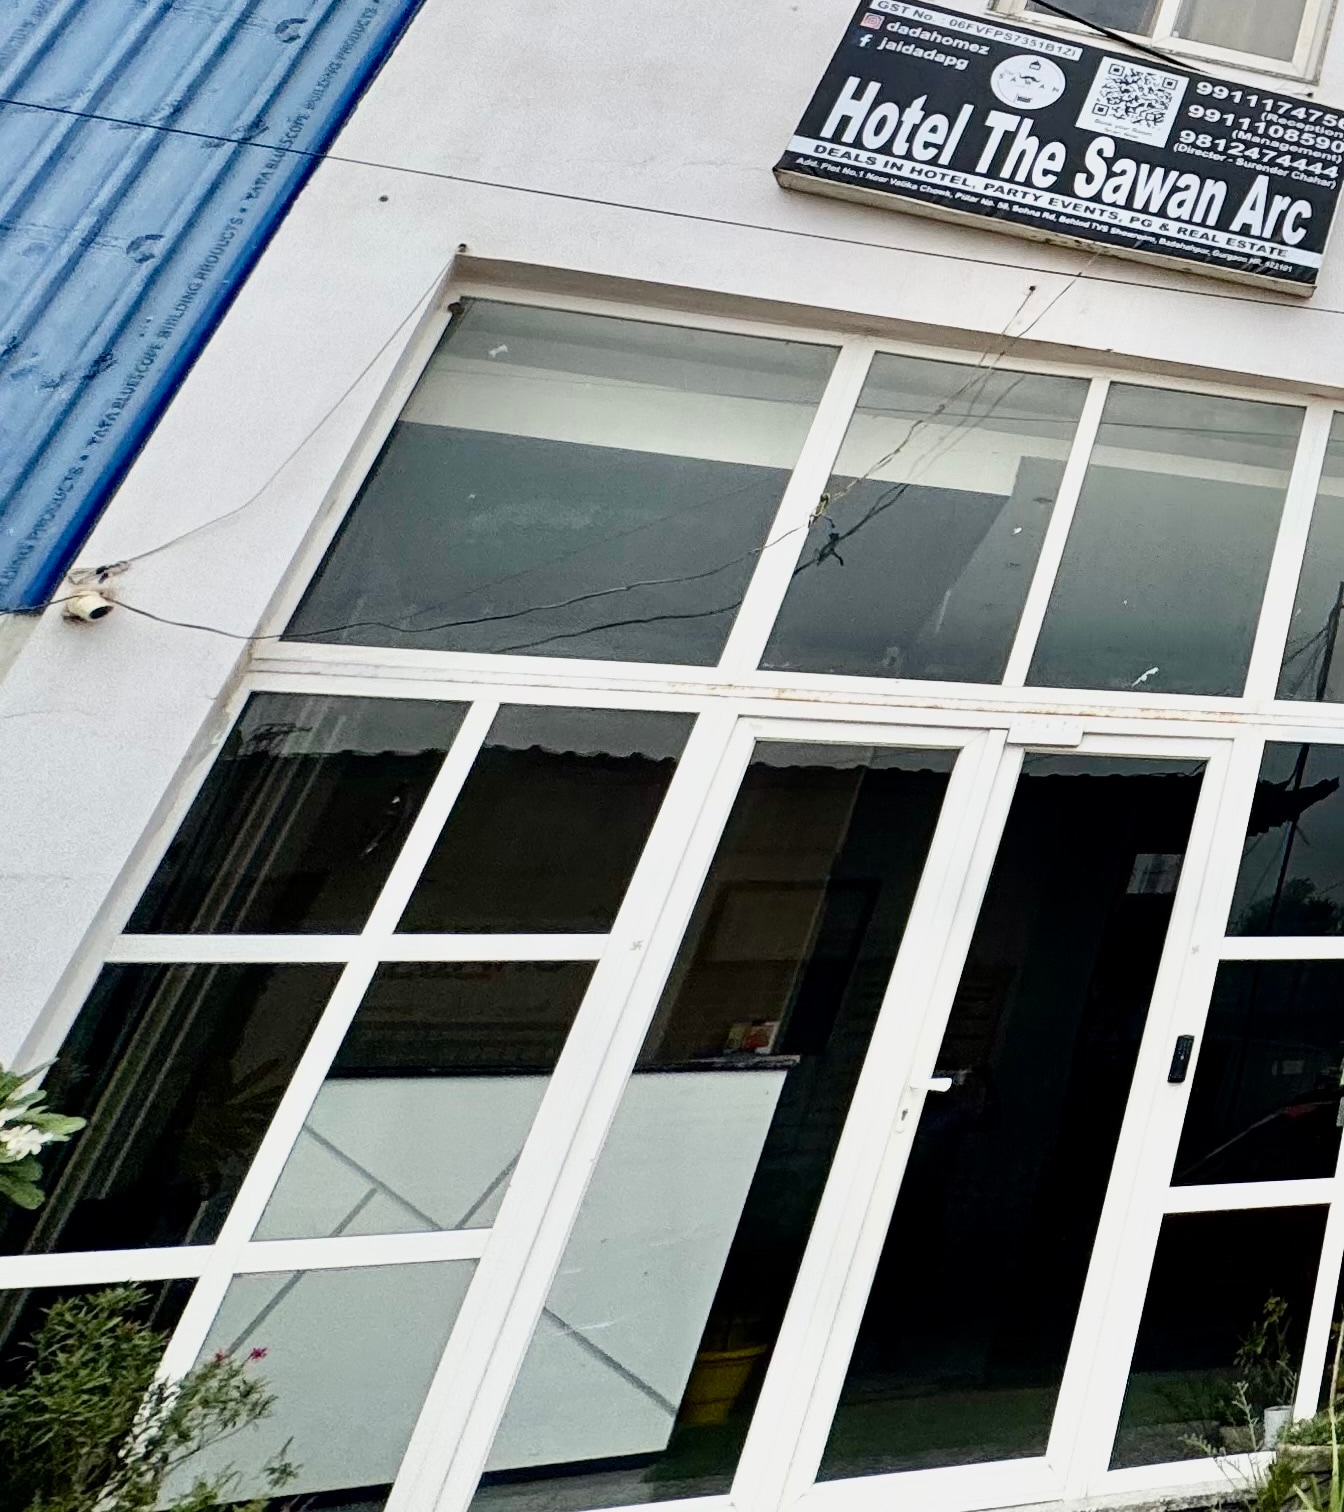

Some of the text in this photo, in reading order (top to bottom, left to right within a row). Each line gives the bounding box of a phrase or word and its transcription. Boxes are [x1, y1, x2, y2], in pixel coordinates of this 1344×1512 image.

[877, 0, 910, 15] GST
[912, 7, 937, 22] No.
[886, 20, 990, 56] dadahomez
[820, 75, 1313, 246] Hotel The Sawan Arc
[1172, 141, 1225, 163] (Director
[1235, 157, 1289, 180] Surender
[1179, 129, 1339, 179] 9812474444
[1231, 128, 1343, 165] (Management)
[813, 144, 1289, 259] DEALS IN HOTEL, PARTY EVENTS, PG & REAL ESTATE
